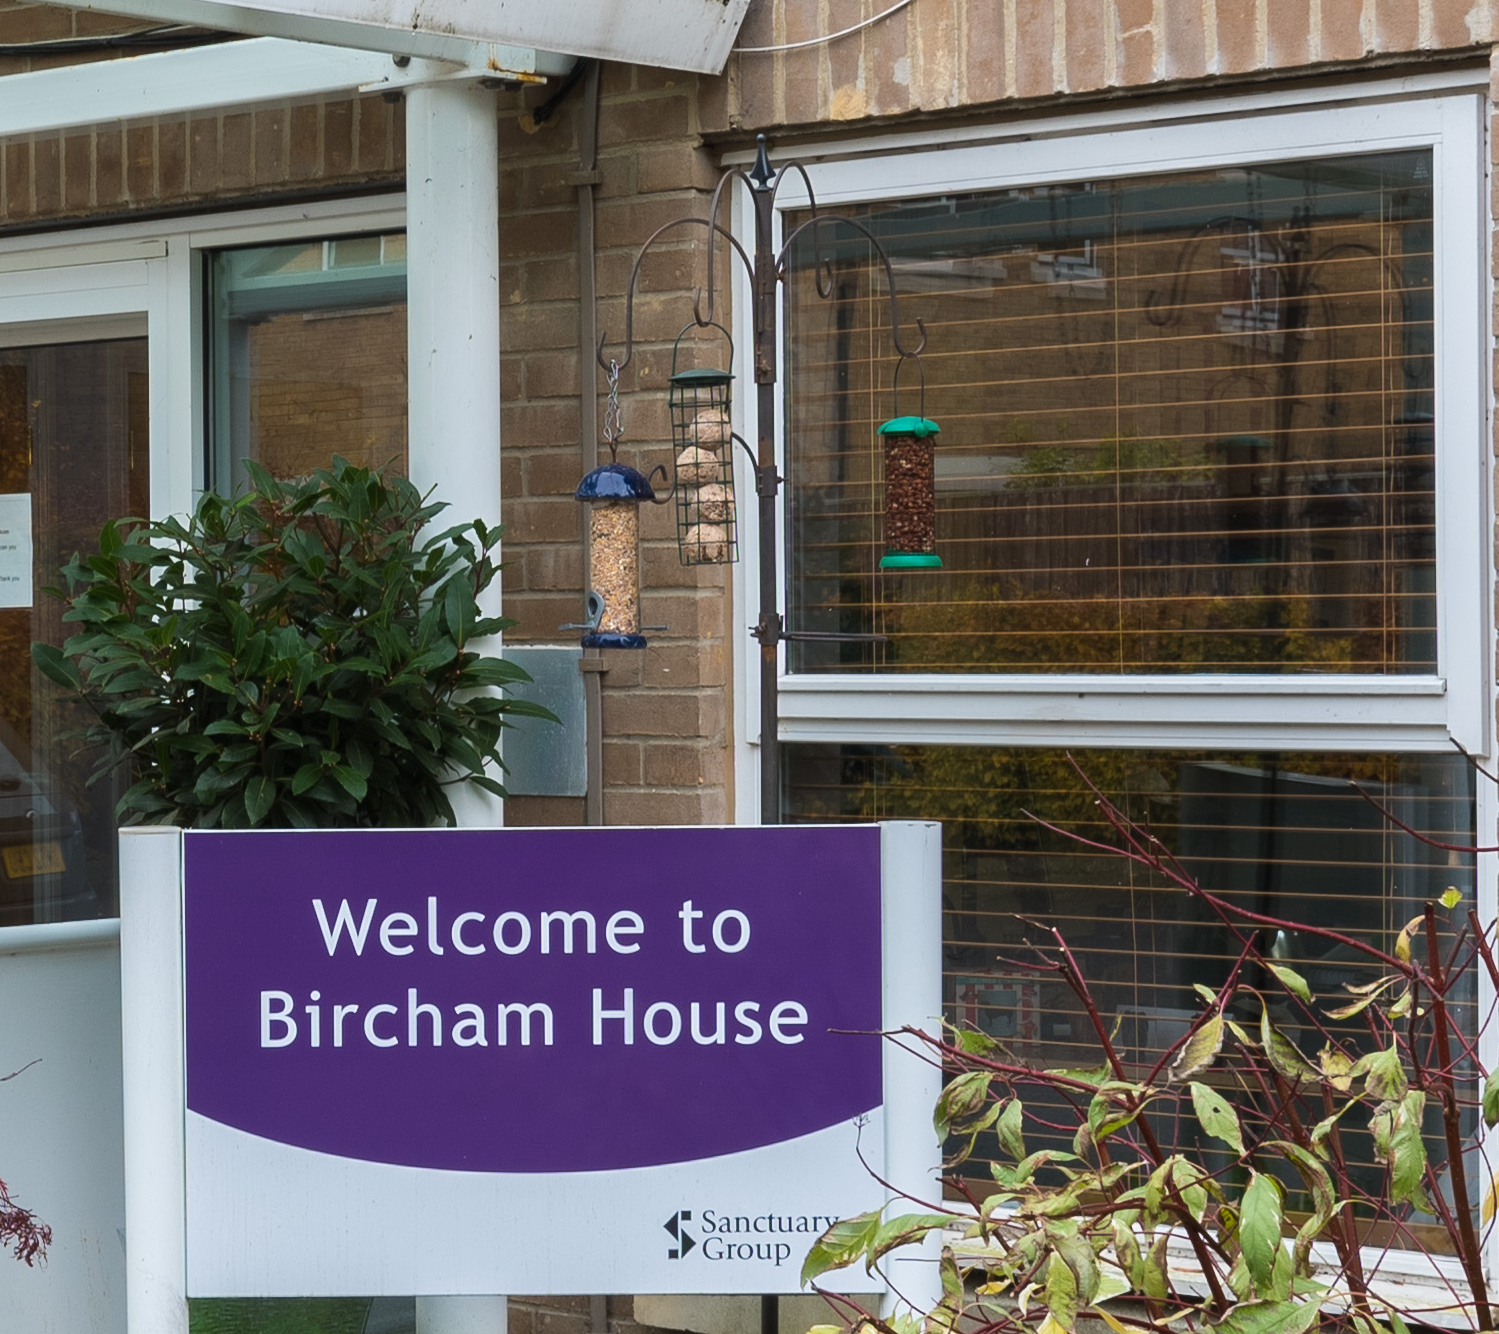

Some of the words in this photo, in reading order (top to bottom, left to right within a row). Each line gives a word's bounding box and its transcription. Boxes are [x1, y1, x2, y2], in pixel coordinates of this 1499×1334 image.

[312, 896, 644, 957] Welcome
[678, 899, 751, 954] to
[260, 987, 554, 1048] Bircham
[592, 987, 808, 1045] House
[703, 1237, 791, 1266] Group
